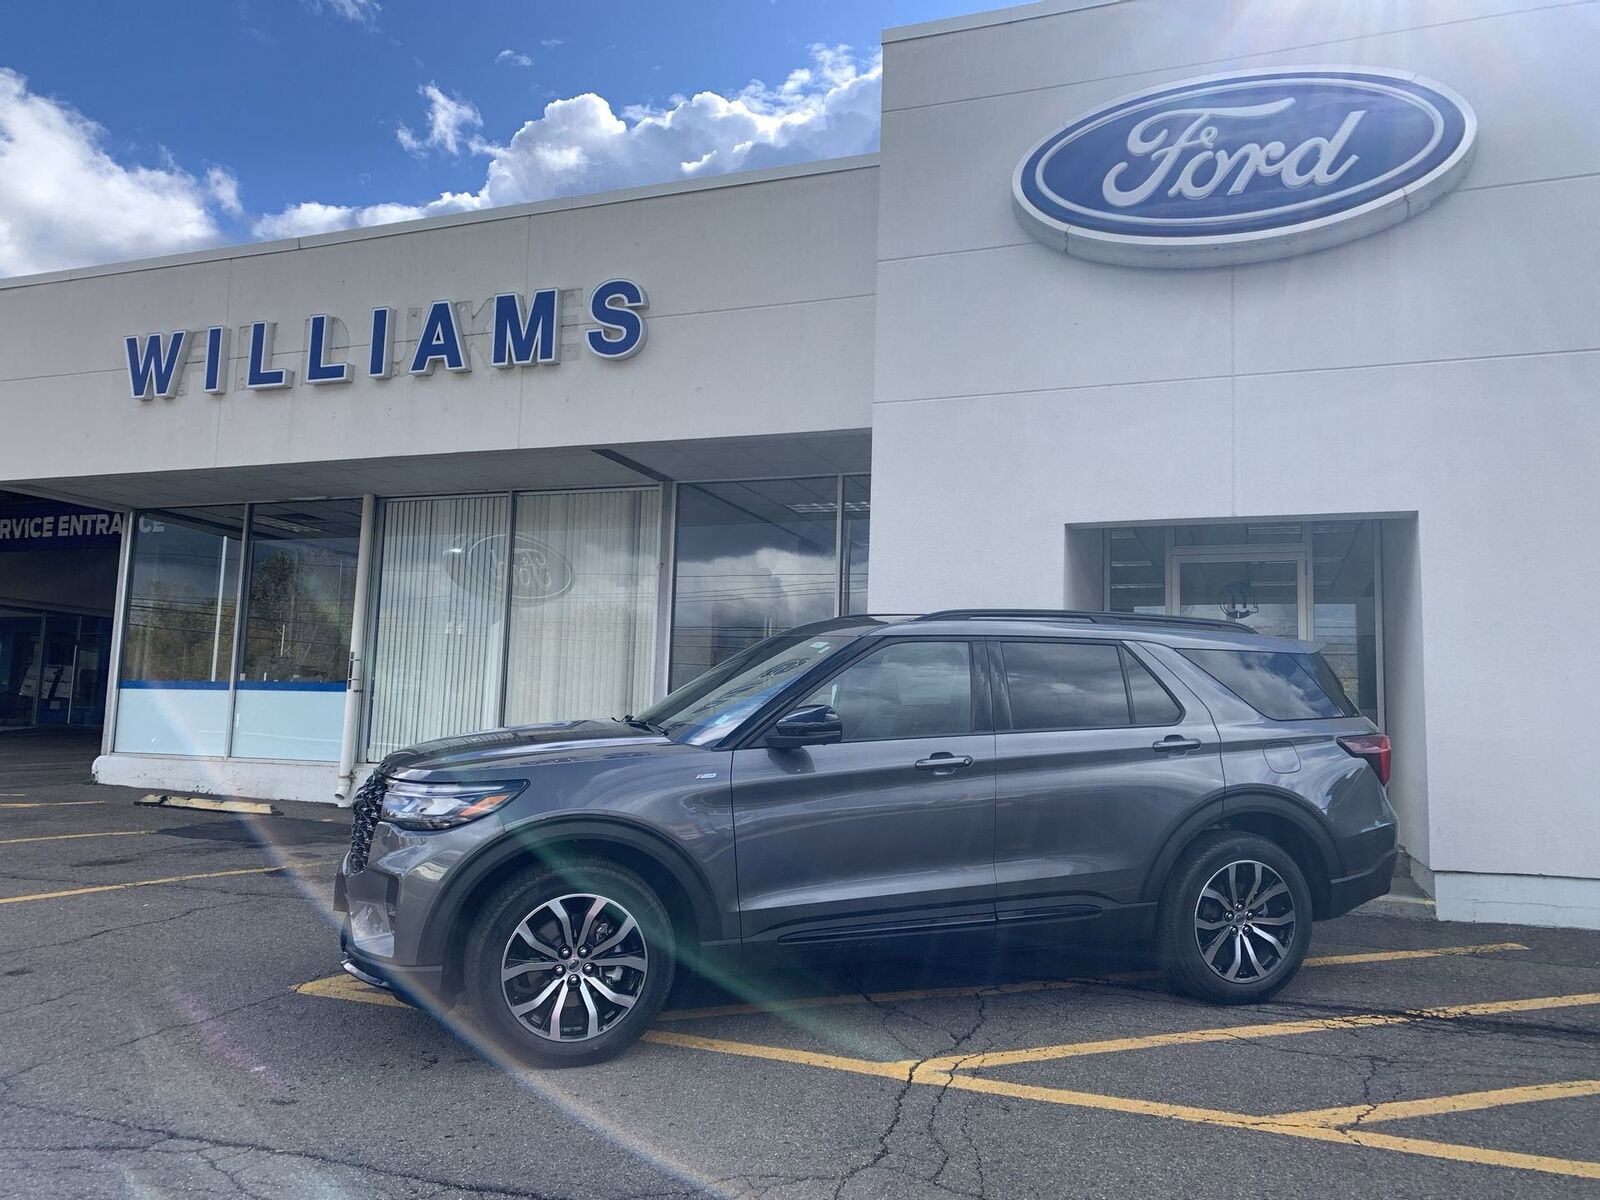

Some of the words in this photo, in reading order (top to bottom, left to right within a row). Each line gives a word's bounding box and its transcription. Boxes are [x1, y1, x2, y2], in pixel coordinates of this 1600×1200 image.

[1102, 97, 1367, 207] Ford
[123, 277, 649, 401] WILLIAMS
[57, 513, 165, 536] ENTRACE
